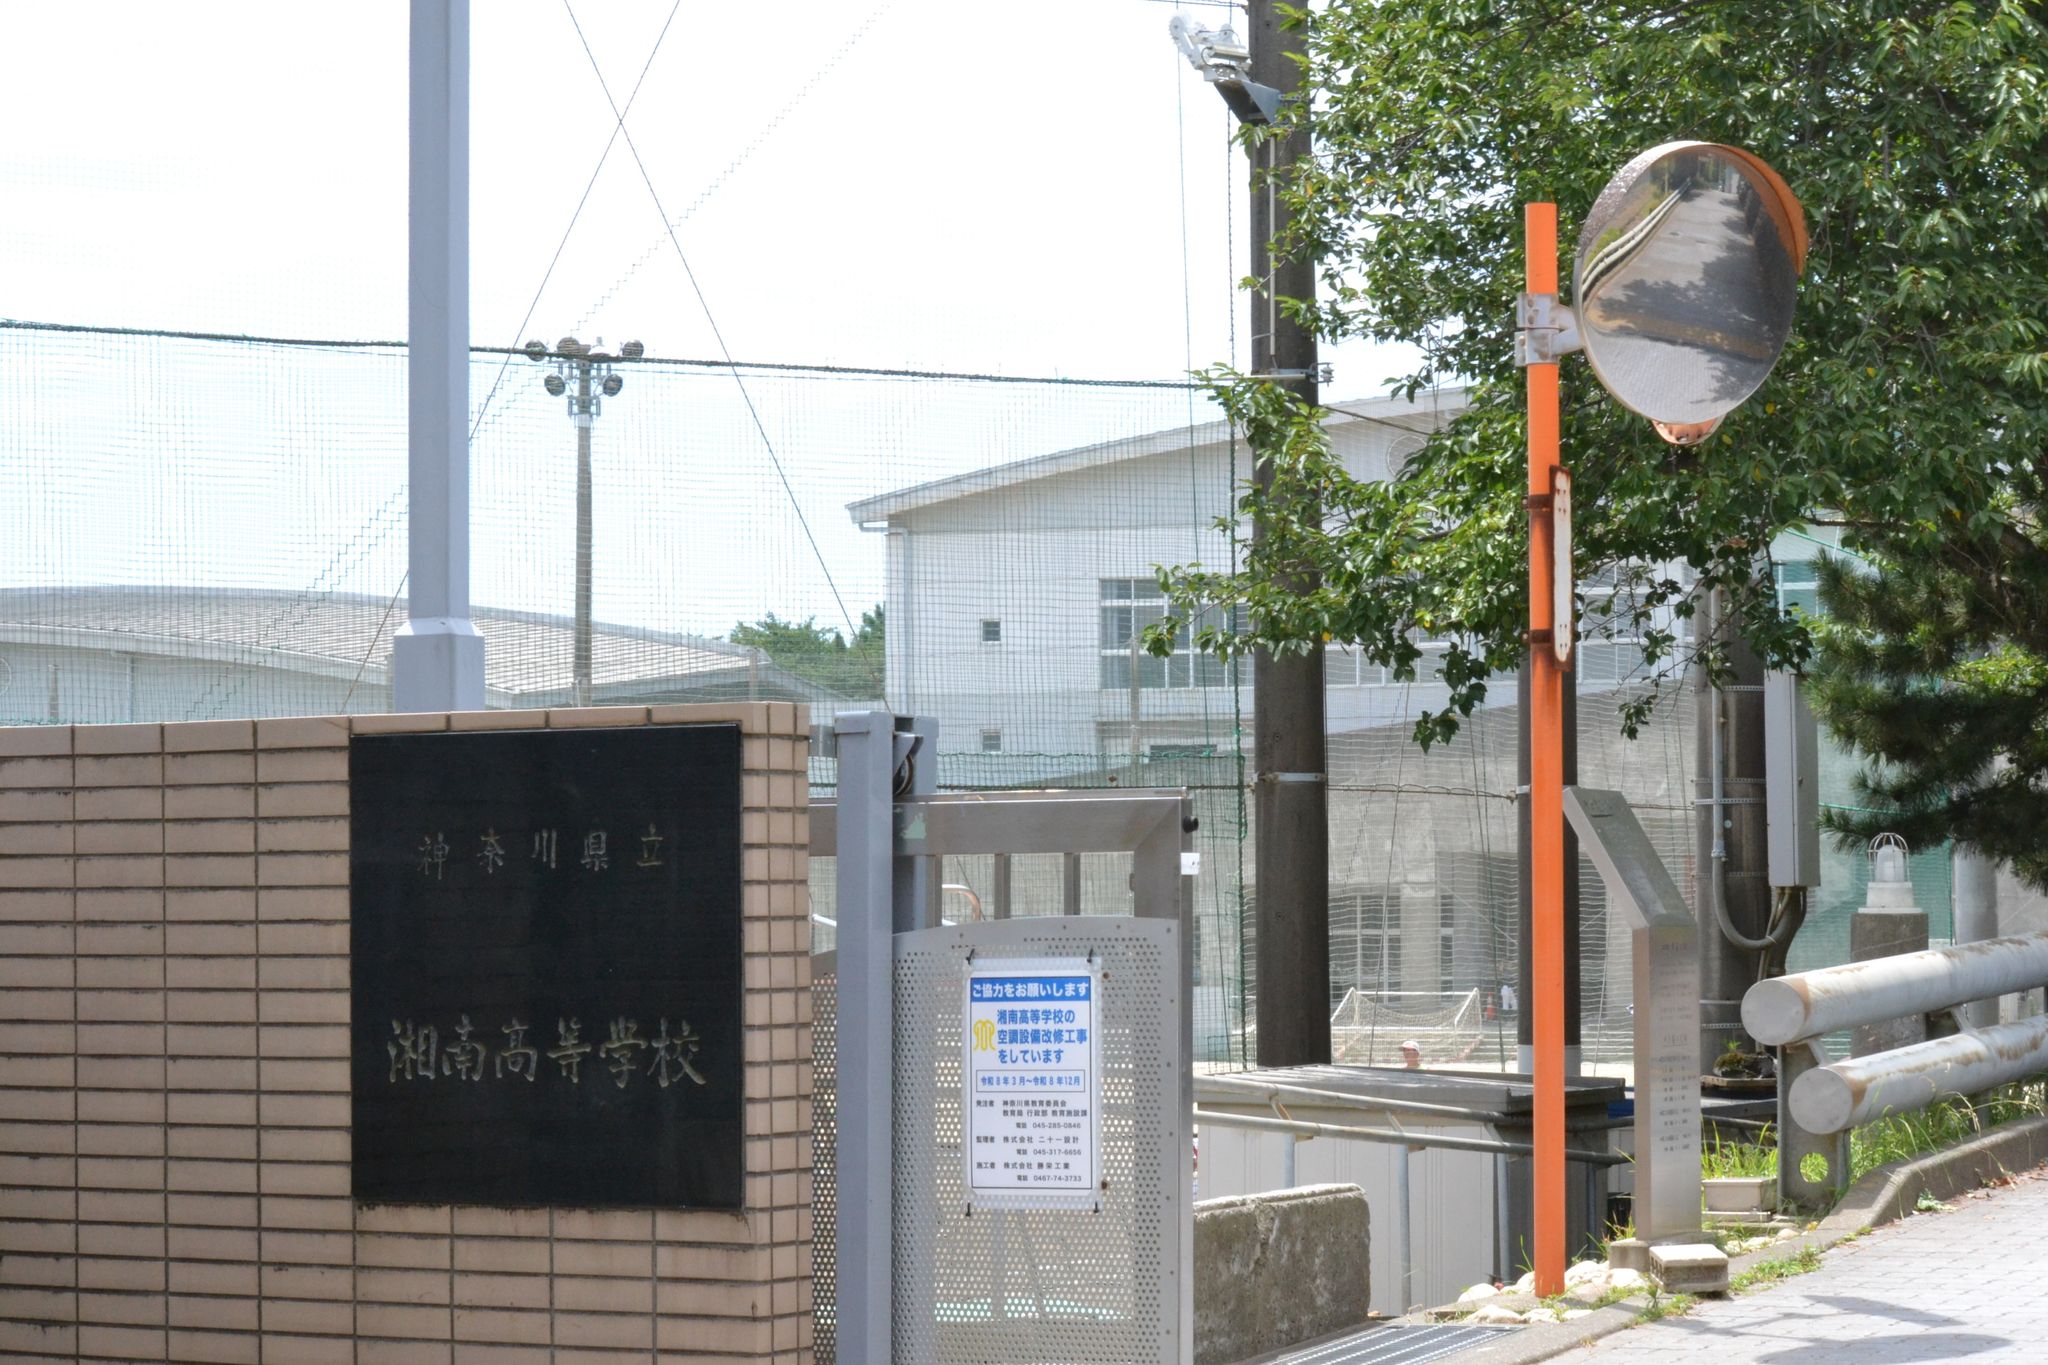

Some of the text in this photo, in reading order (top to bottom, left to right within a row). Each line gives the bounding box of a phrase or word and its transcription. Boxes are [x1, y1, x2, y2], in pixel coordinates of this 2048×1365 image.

[418, 822, 665, 880] 神奈川県立
[972, 983, 1089, 998] ご協力をお願いします
[997, 1009, 1075, 1025] 湘南高等学校の
[997, 1029, 1088, 1045] 空調設備改修工事
[998, 1049, 1064, 1064] をしています
[1002, 1099, 1067, 1108] 神奈川県教育委員会
[1003, 1136, 1034, 1144] 株式会社
